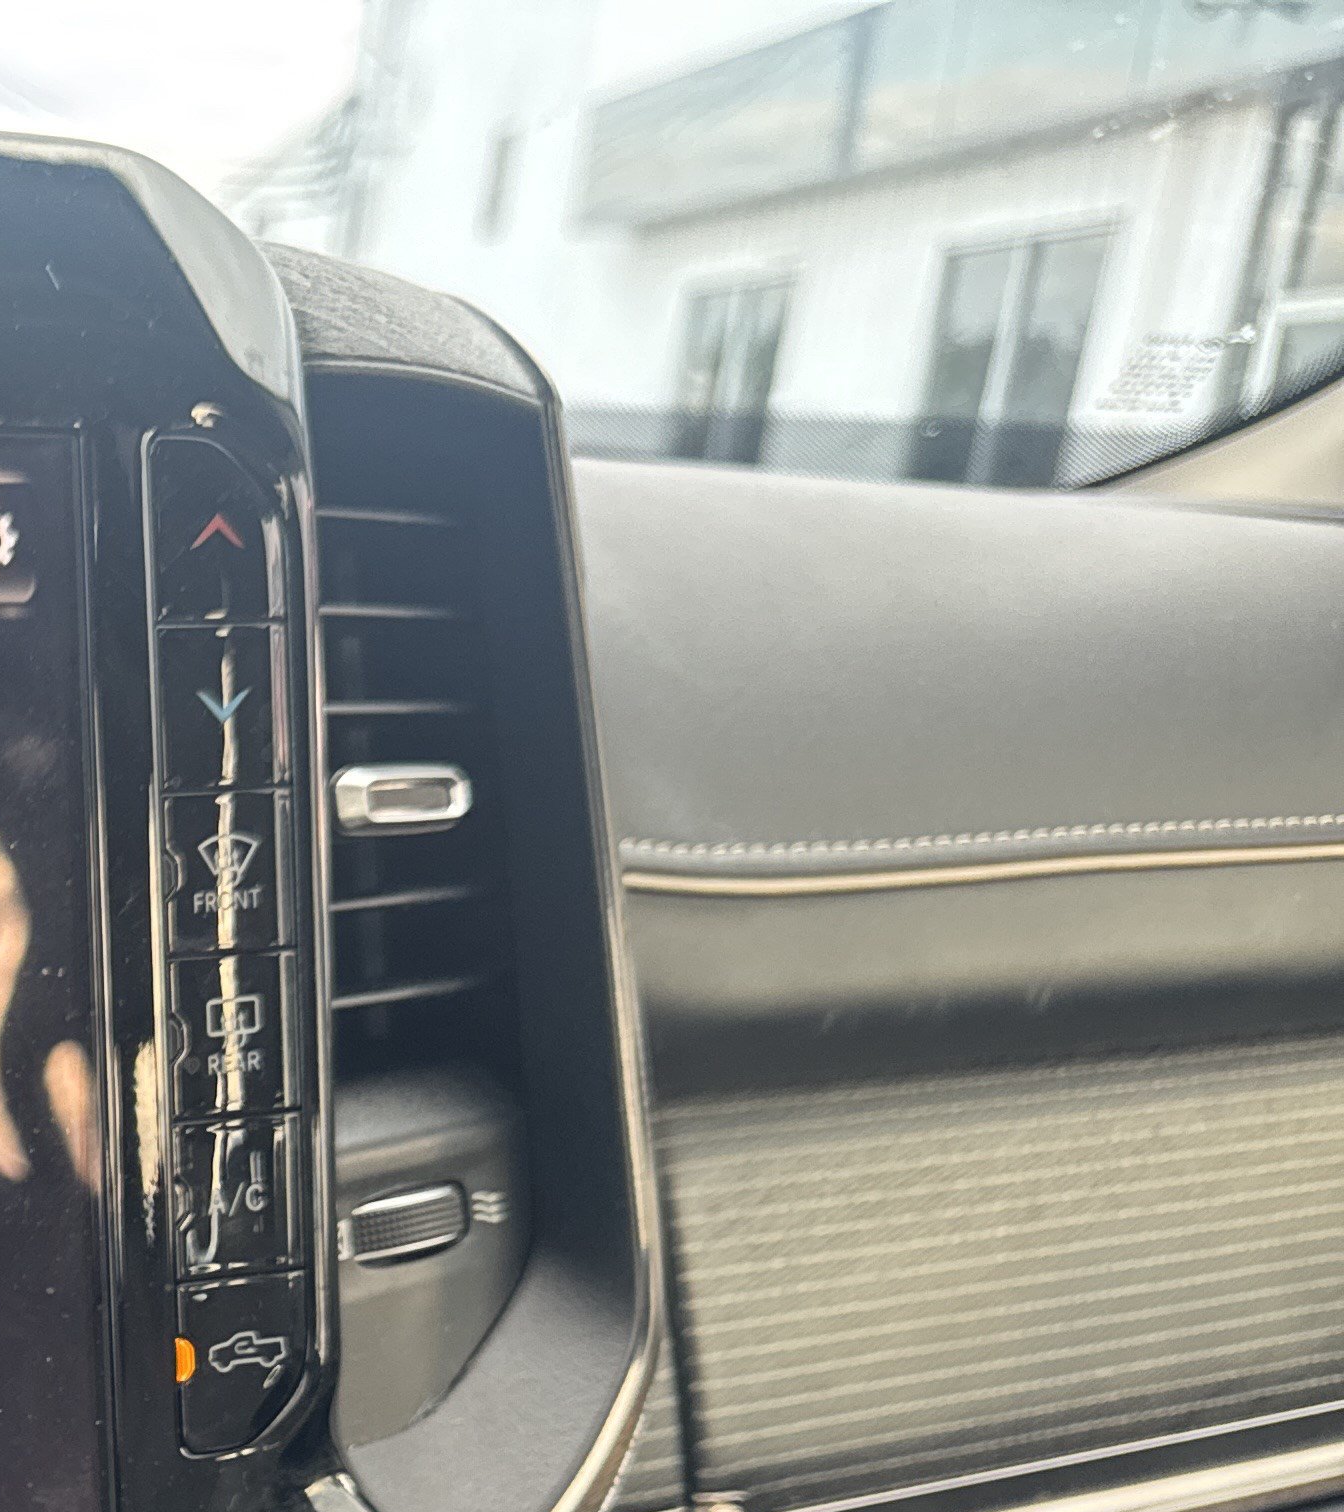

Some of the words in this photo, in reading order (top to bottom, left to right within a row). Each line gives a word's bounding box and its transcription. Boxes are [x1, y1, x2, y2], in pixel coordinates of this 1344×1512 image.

[193, 887, 261, 914] FRONT
[208, 1050, 262, 1076] REAR
[208, 1181, 266, 1217] A/C
